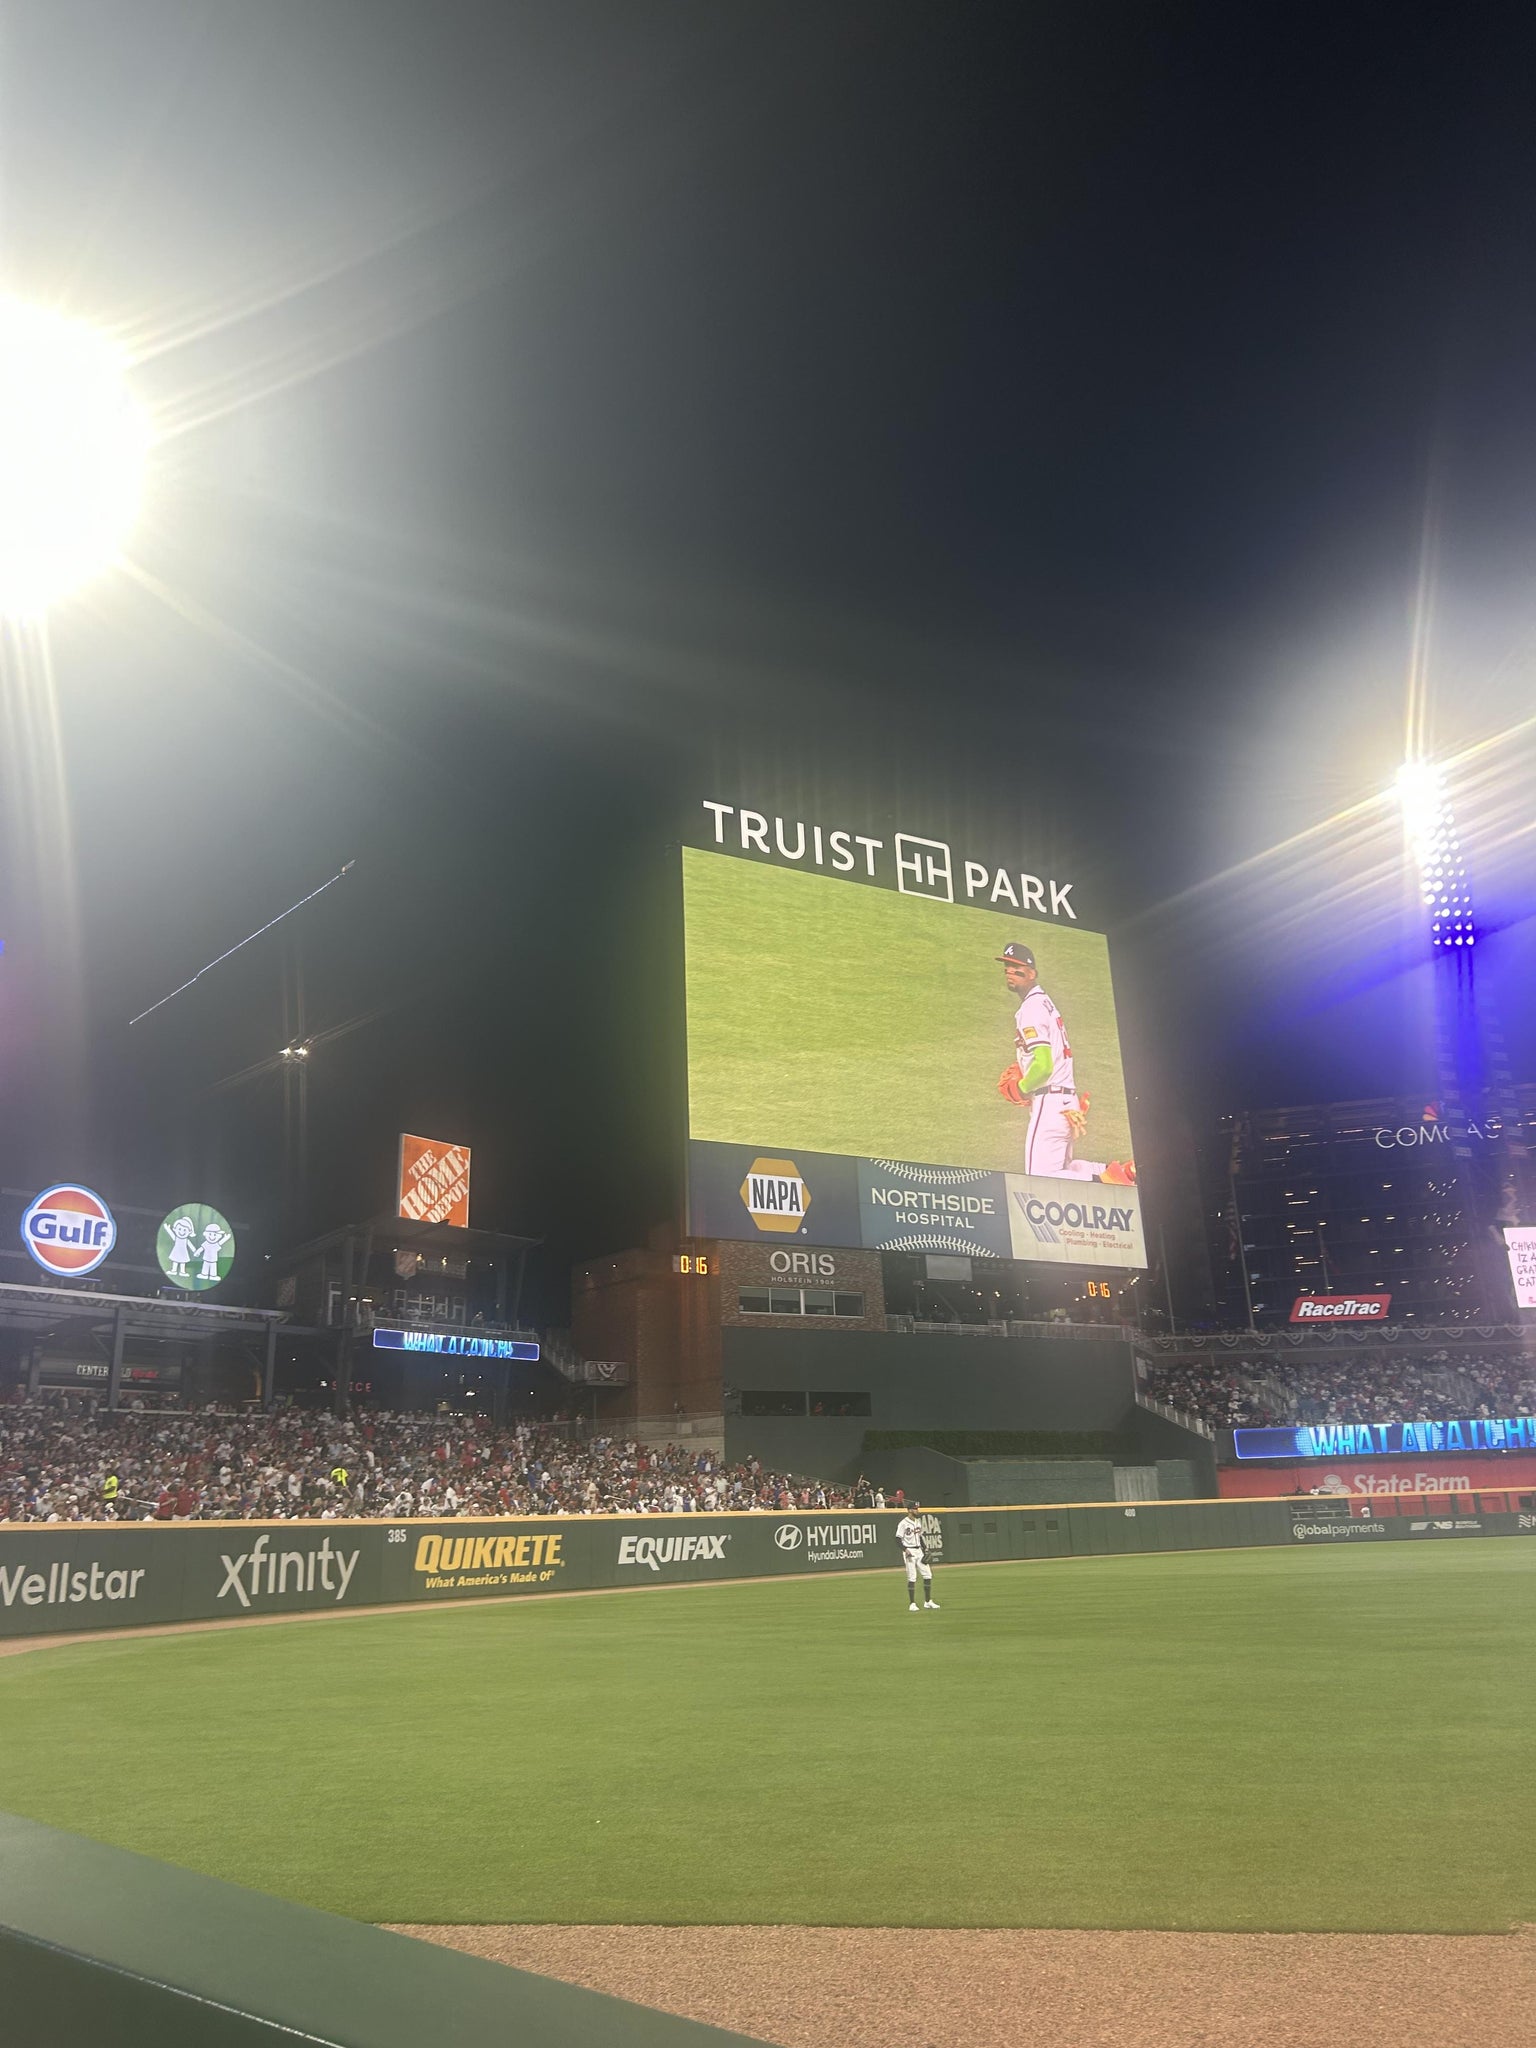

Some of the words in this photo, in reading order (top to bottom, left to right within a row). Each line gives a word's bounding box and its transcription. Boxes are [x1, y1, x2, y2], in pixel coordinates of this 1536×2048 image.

[703, 800, 883, 876] TRUIST
[964, 861, 1077, 919] PARK
[1375, 1119, 1503, 1149] COMAS
[408, 1149, 437, 1180] THE
[400, 1146, 470, 1220] HOME
[426, 1178, 468, 1223] DEPOT
[752, 1178, 802, 1212] NAPA
[871, 1187, 995, 1215] NORTHSIDE
[896, 1211, 975, 1229] HOSPITAL
[1026, 1199, 1134, 1232] COOLRAY
[29, 1213, 108, 1246] Gulf
[1059, 1228, 1085, 1239] Cooling
[1090, 1231, 1116, 1241] Heating
[1066, 1238, 1098, 1248] Plumbing
[1103, 1240, 1133, 1249] Electrical
[679, 1255, 708, 1275] 0:16
[769, 1250, 836, 1276] ORIS
[771, 1276, 812, 1284] HOLSTEIN
[1087, 1281, 1111, 1298] 0:16
[1298, 1300, 1381, 1317] RaceTrac
[403, 1331, 446, 1353] WHAT
[448, 1336, 457, 1354] A
[76, 1364, 109, 1377] CENTER
[330, 1380, 373, 1393] SICE
[1308, 1423, 1392, 1456] WHAT
[1401, 1422, 1420, 1452] A
[1425, 1418, 1536, 1452] CATCH!
[916, 1514, 942, 1535] APA
[1293, 1523, 1385, 1539] globalpayments
[388, 1529, 407, 1543] 385
[807, 1525, 877, 1547] HYUNDAI
[414, 1534, 562, 1574] QUIKRETE
[618, 1535, 728, 1571] EQUIFAX
[807, 1549, 864, 1563] HyundaiUSA.com
[217, 1535, 360, 1607] xfinity
[425, 1576, 454, 1589] What
[456, 1573, 507, 1587] America's
[510, 1571, 537, 1584] Made
[539, 1571, 551, 1582] Of
